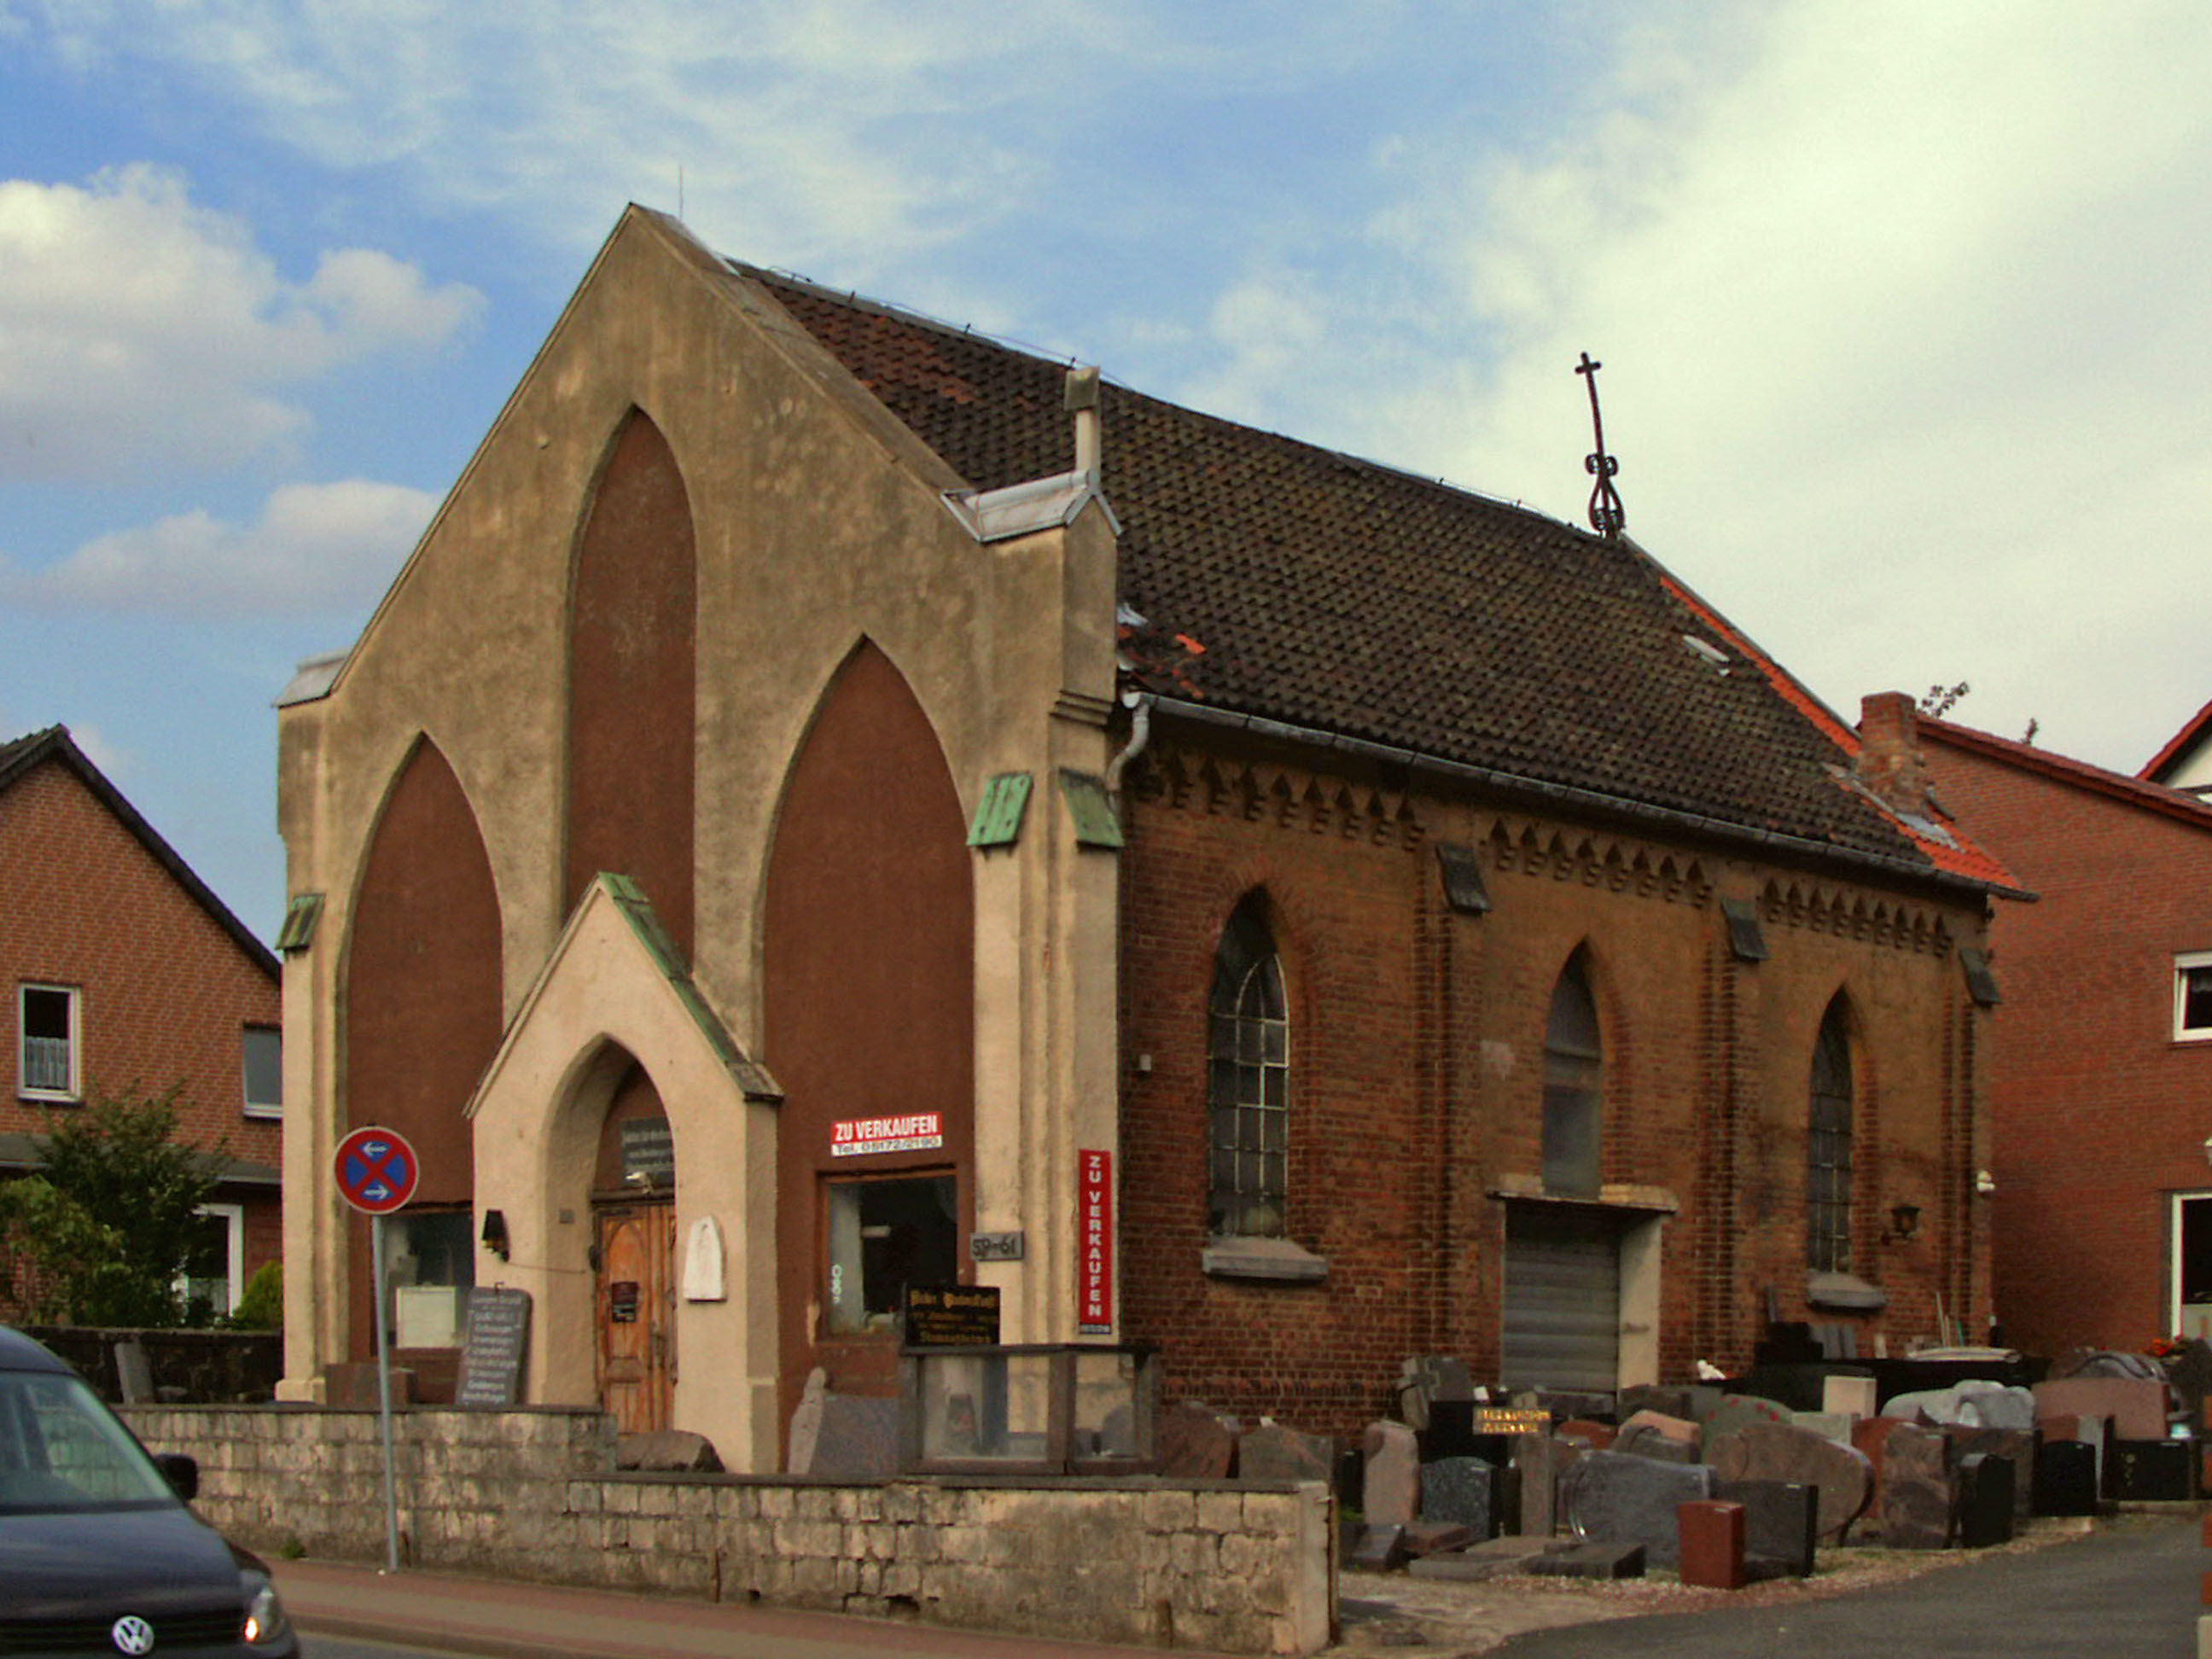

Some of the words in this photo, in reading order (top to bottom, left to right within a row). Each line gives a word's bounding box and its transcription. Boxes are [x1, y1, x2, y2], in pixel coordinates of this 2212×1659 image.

[835, 1122, 853, 1141] ZU
[856, 1115, 937, 1138] VERKAUFEN
[1089, 1155, 1102, 1184] ZU
[1089, 1190, 1102, 1317] VERKAUFEN
